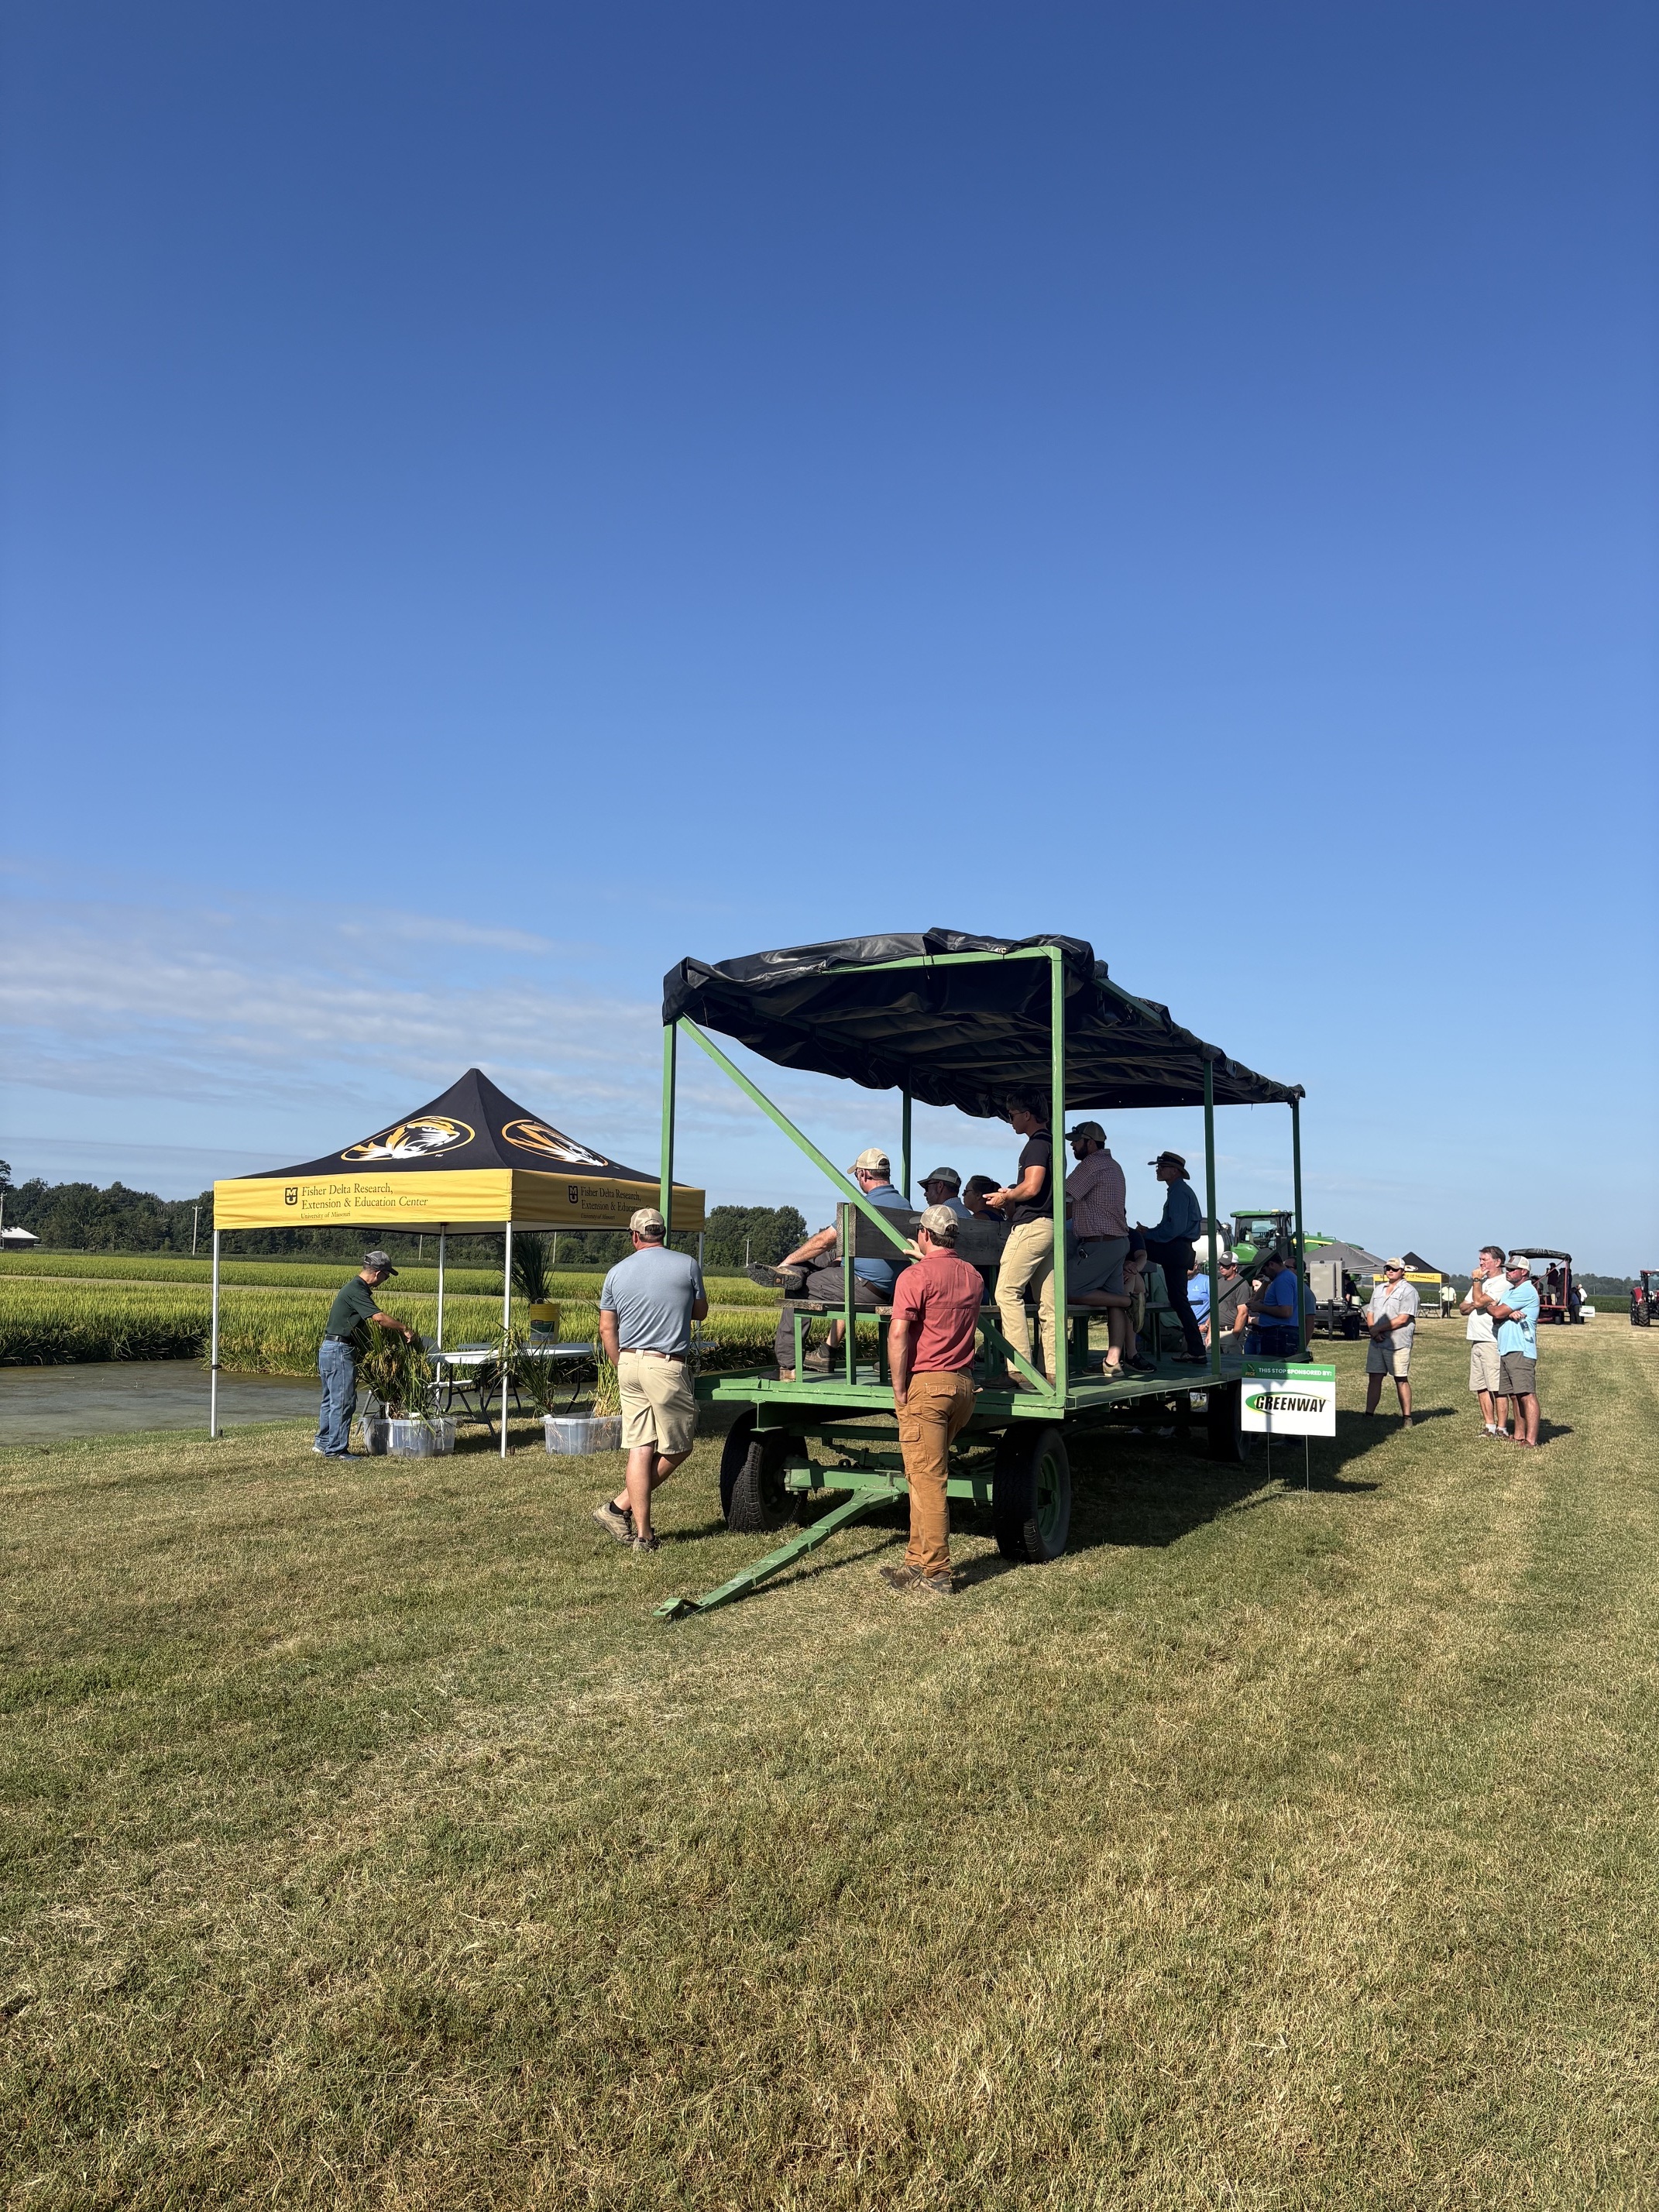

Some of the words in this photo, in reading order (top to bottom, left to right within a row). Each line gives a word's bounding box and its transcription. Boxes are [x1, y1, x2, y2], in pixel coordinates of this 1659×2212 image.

[301, 1186, 327, 1197] Fisher
[329, 1183, 351, 1195] Delta
[354, 1183, 393, 1194] Research,
[580, 1187, 598, 1197] Fisher
[599, 1187, 615, 1198] Delta
[616, 1189, 641, 1202] Research,
[301, 1199, 342, 1210] Extension
[344, 1197, 352, 1207] &
[355, 1197, 397, 1207] Education
[399, 1196, 429, 1206] Center
[582, 1200, 610, 1211] Extension
[610, 1203, 616, 1211] &
[617, 1202, 644, 1213] Educatio
[1255, 1396, 1327, 1413] GREENWAY
